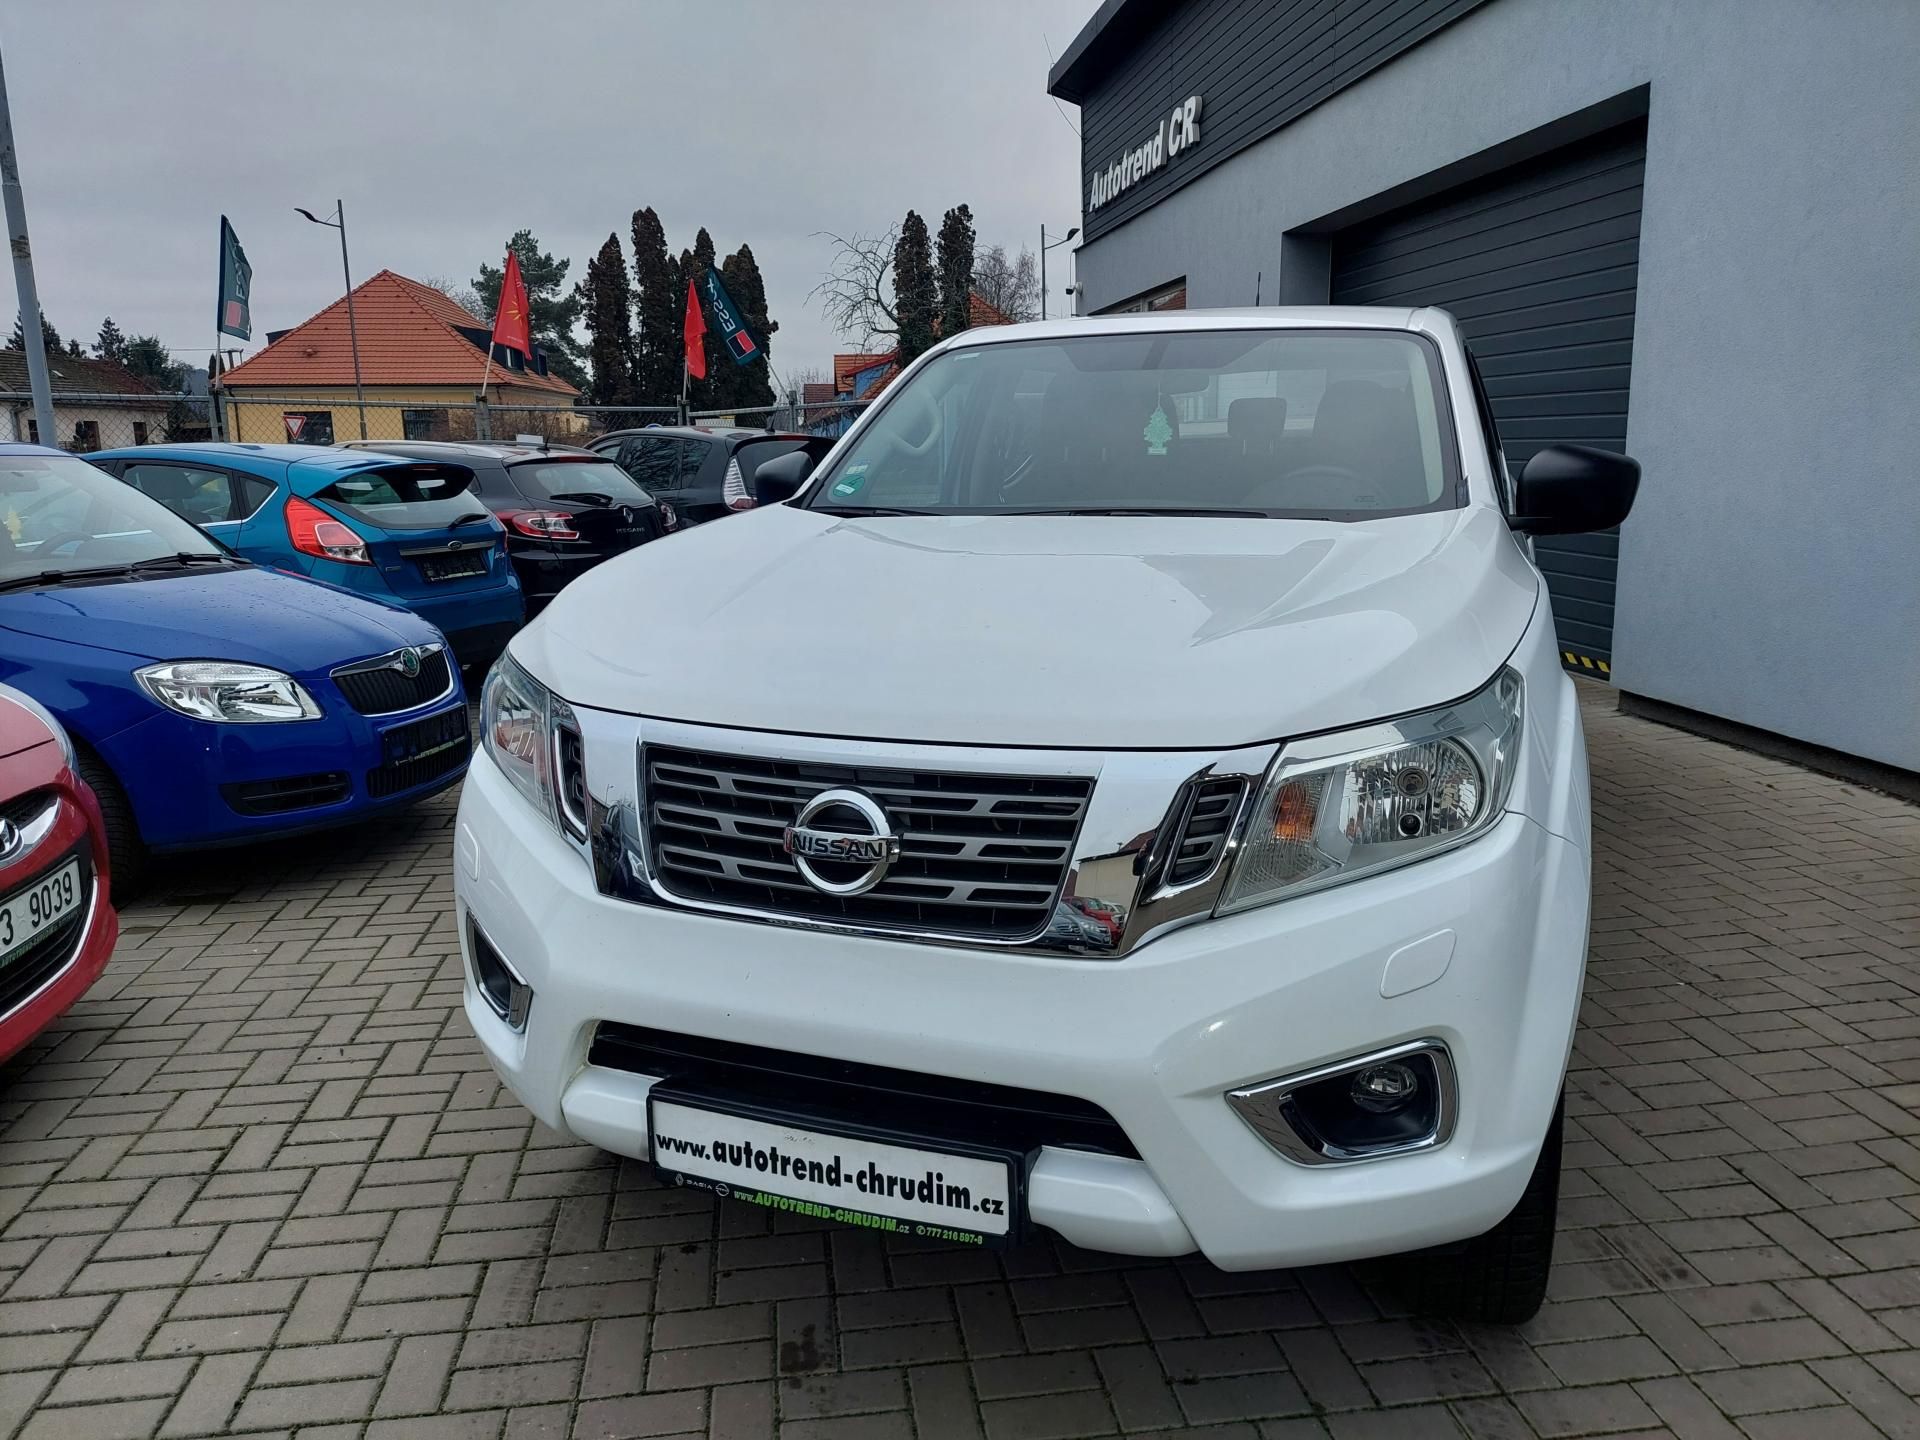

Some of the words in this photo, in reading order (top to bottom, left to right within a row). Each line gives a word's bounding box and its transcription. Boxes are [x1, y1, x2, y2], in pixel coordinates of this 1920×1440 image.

[1089, 119, 1167, 213] Autotrend
[1168, 95, 1203, 157] CR
[792, 834, 884, 858] NISSAN
[29, 871, 72, 927] 9039
[656, 1133, 1004, 1216] www.autotrend-chrudim.cz
[926, 1227, 942, 1237] 777
